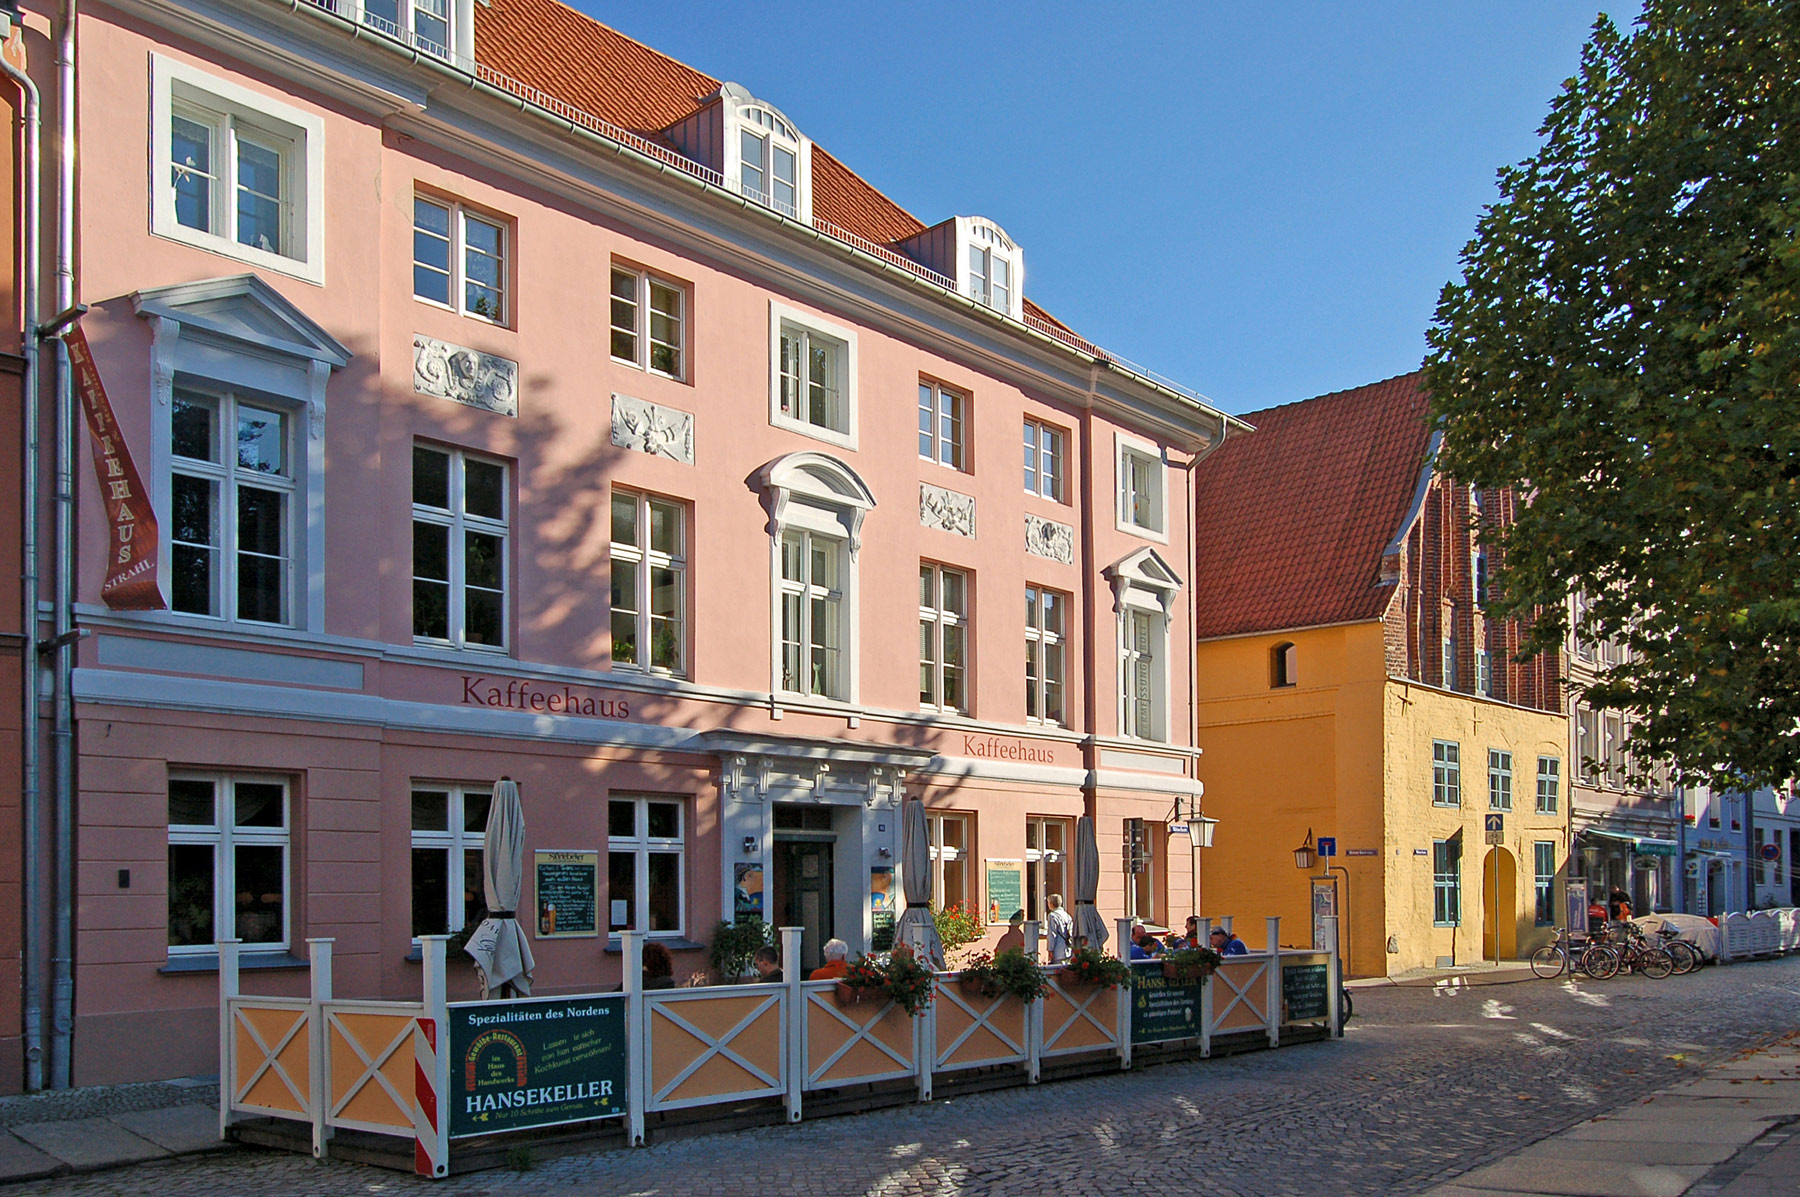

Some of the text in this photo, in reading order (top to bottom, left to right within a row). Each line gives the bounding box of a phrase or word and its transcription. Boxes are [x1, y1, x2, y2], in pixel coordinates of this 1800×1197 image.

[70, 341, 134, 564] KAFFEEHAUS
[104, 559, 155, 591] STRAHL
[460, 675, 630, 719] Kaffeehaus
[962, 735, 1055, 764] Kaffeehaus
[468, 1005, 610, 1027] Spezialitäten des Nordens
[466, 1080, 613, 1114] HANSEKELLER
[478, 1076, 515, 1086] Handwerks
